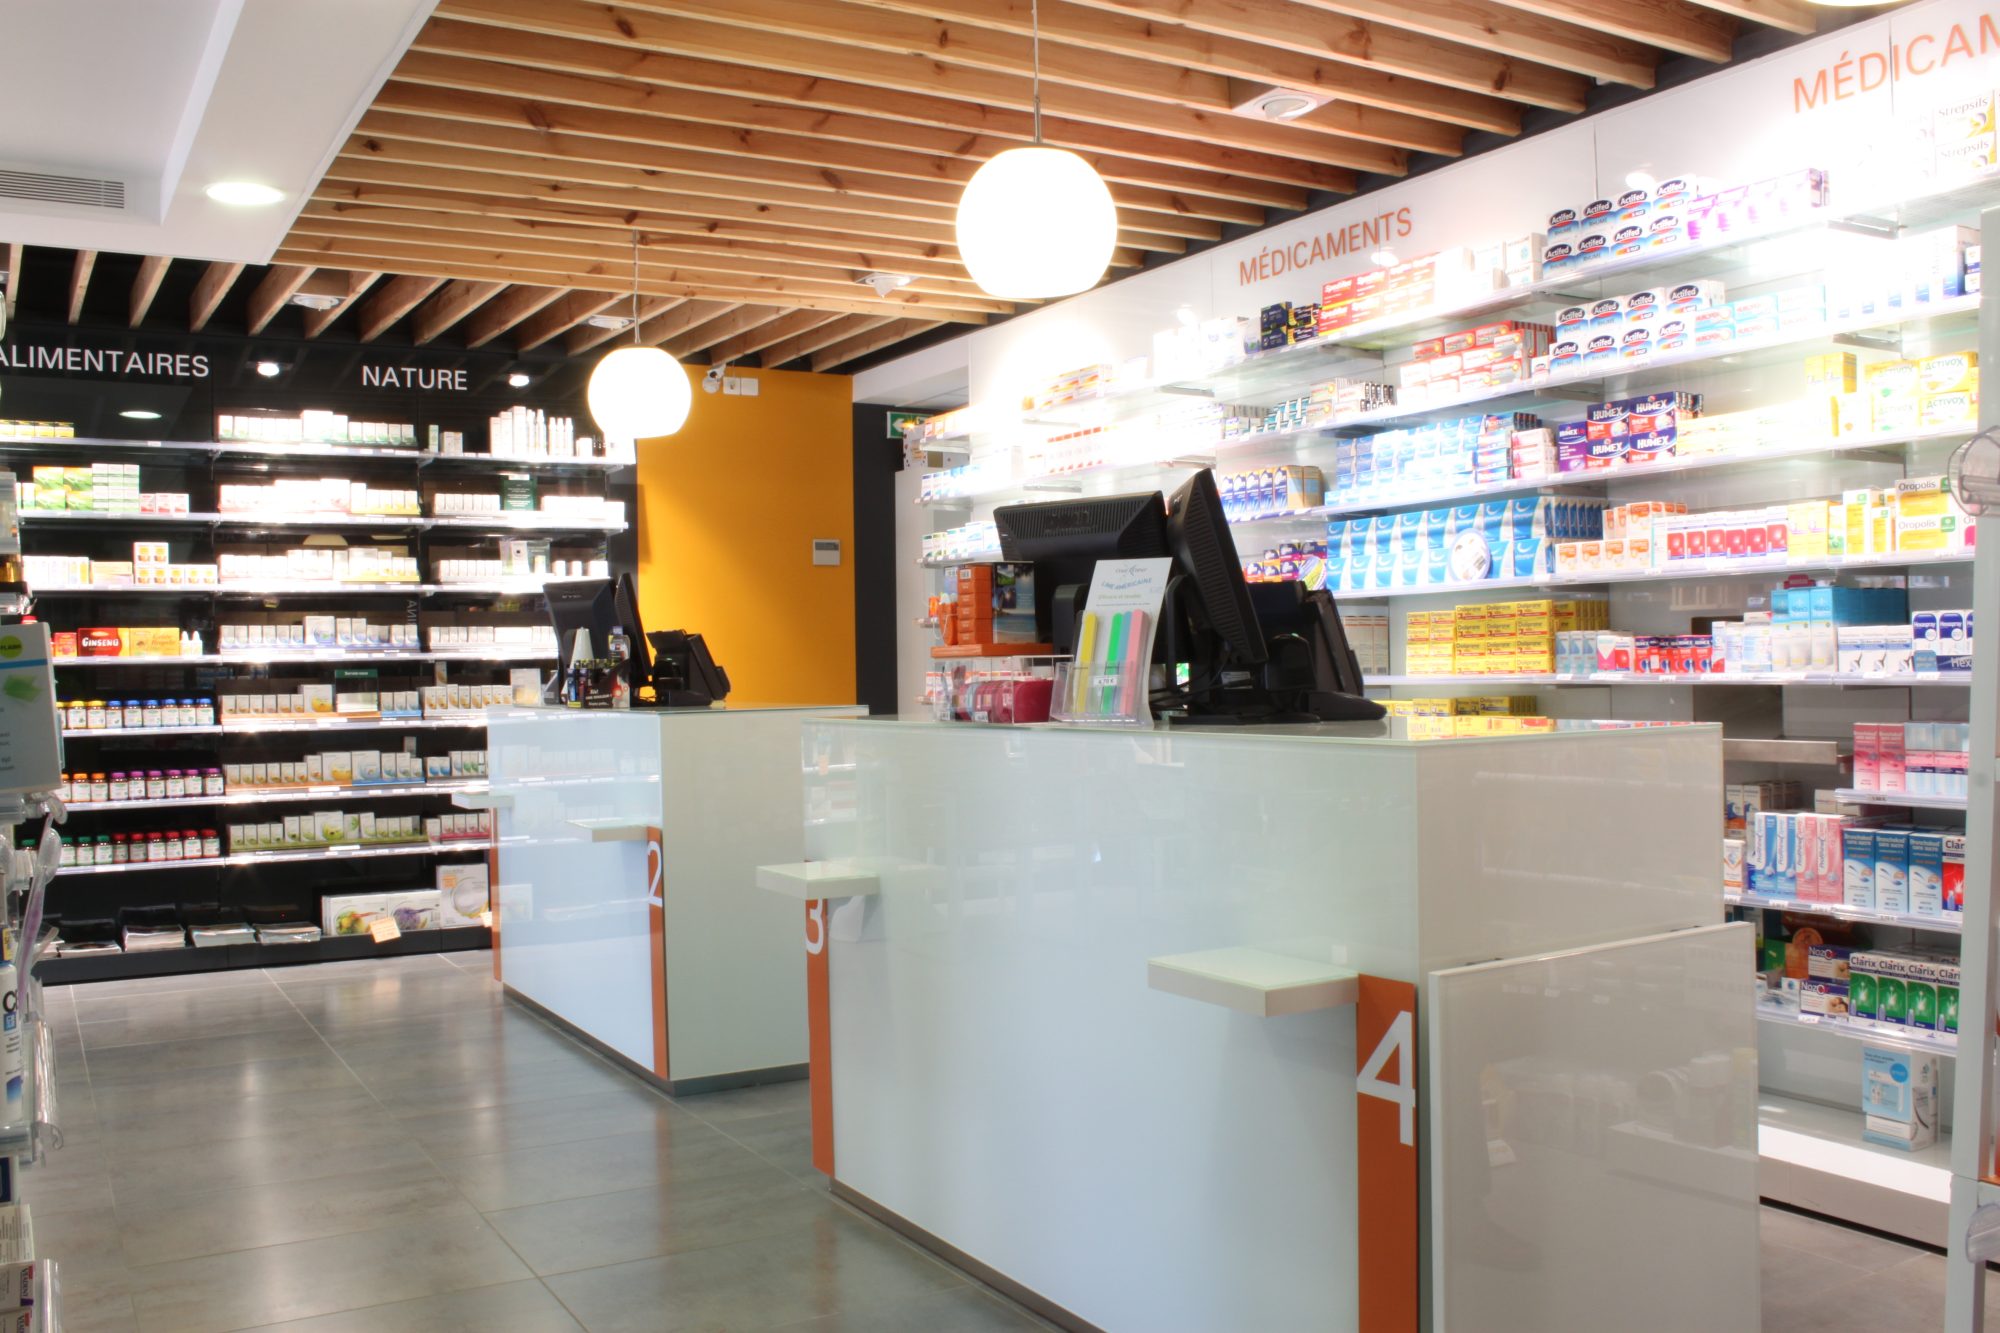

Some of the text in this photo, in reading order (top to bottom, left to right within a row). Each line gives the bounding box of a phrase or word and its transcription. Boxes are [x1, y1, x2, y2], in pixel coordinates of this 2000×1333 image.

[1938, 98, 1988, 117] Strepsils
[1657, 181, 1684, 196] Actifed
[1619, 192, 1645, 206] Actifed
[1586, 202, 1610, 216] Actifed
[1551, 211, 1574, 225] Actifed
[1651, 218, 1677, 231] Actifed
[1615, 228, 1641, 241] Actifed
[1239, 207, 1413, 286] MÉDICAMENTS
[1580, 237, 1604, 250] Actifed
[1546, 246, 1570, 259] Actifed
[1671, 286, 1697, 300] Actifed
[1629, 294, 1654, 307] Actifed
[1593, 302, 1617, 314] Actifed
[1560, 309, 1583, 322] Actifed
[1660, 323, 1684, 336] Actifed
[1589, 336, 1613, 349] Actifed
[1624, 330, 1648, 343] Actifed
[1554, 342, 1577, 356] Actifed
[362, 365, 468, 391] NATURE
[1636, 399, 1667, 413] HUMEX
[1593, 406, 1623, 420] HUMEX
[1593, 442, 1623, 455] HUMEX
[1637, 435, 1668, 449] HUMEX
[1898, 481, 1936, 492] Oropolis
[1898, 519, 1936, 530] Oropolis
[82, 637, 119, 647] GINSENG
[647, 840, 663, 908] 2
[806, 898, 824, 955] 3
[1850, 957, 1877, 969] Clarix
[1878, 960, 1906, 973] Clarix
[1908, 964, 1936, 977] Clarix
[1356, 1010, 1416, 1147] 4
